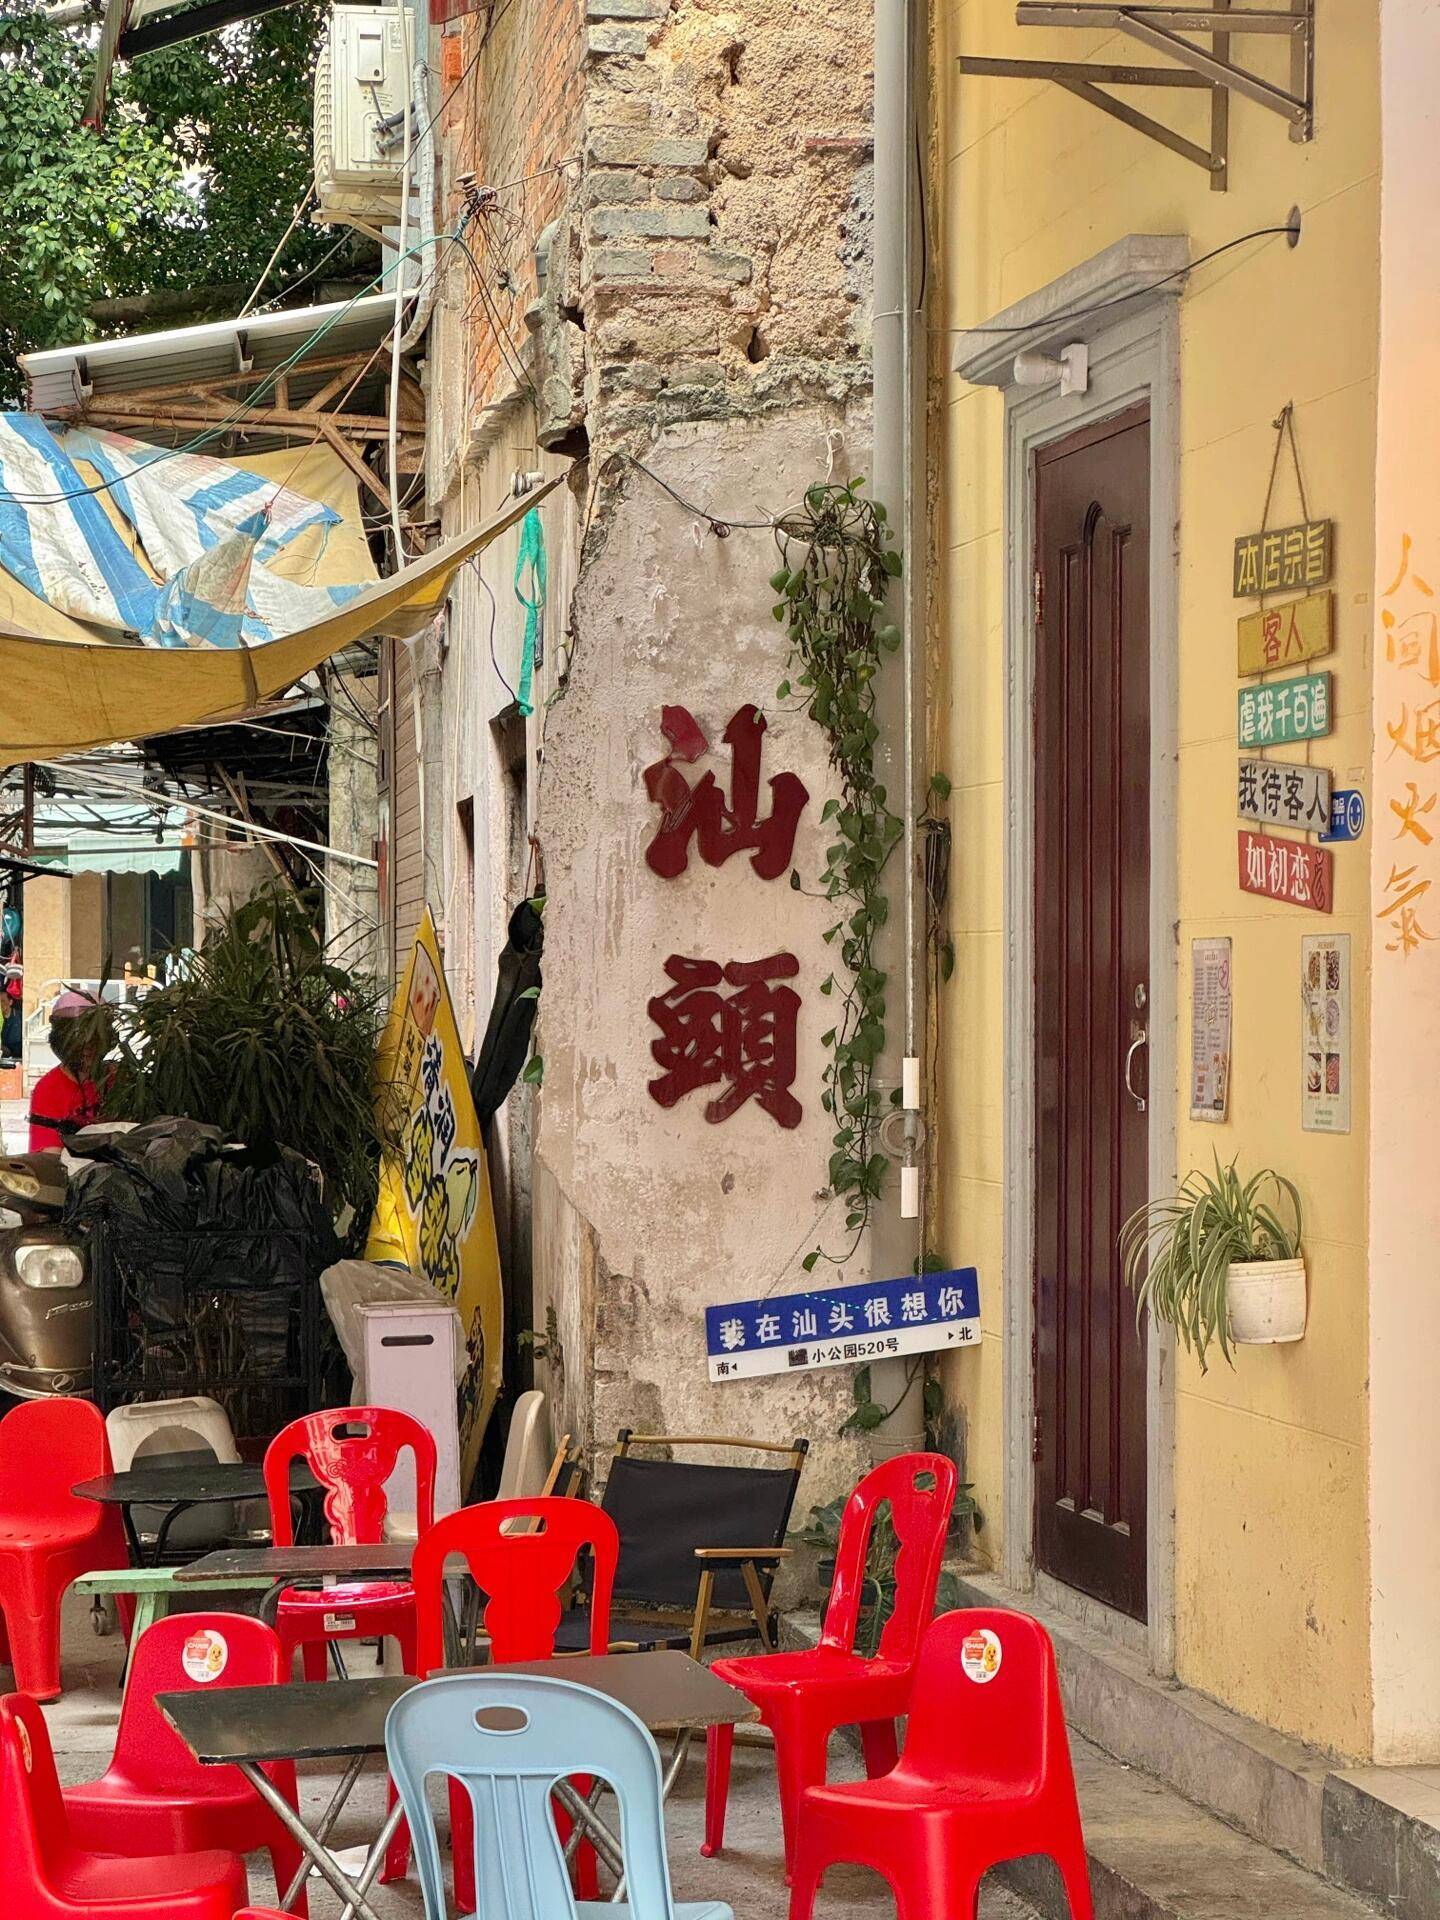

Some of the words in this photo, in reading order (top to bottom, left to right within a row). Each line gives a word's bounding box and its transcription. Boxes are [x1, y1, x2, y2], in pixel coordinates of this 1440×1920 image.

[1237, 523, 1325, 592] 本店宗旨
[1263, 603, 1303, 665] 客人
[1239, 679, 1327, 742] 虐我千百遍
[1238, 764, 1328, 824] 我待客人
[1245, 835, 1311, 901] 如初恋
[719, 1286, 965, 1350] 我在汕头很想你
[959, 1326, 973, 1341] 北
[716, 1361, 730, 1375] 南
[812, 1337, 900, 1363] 小公园520号
